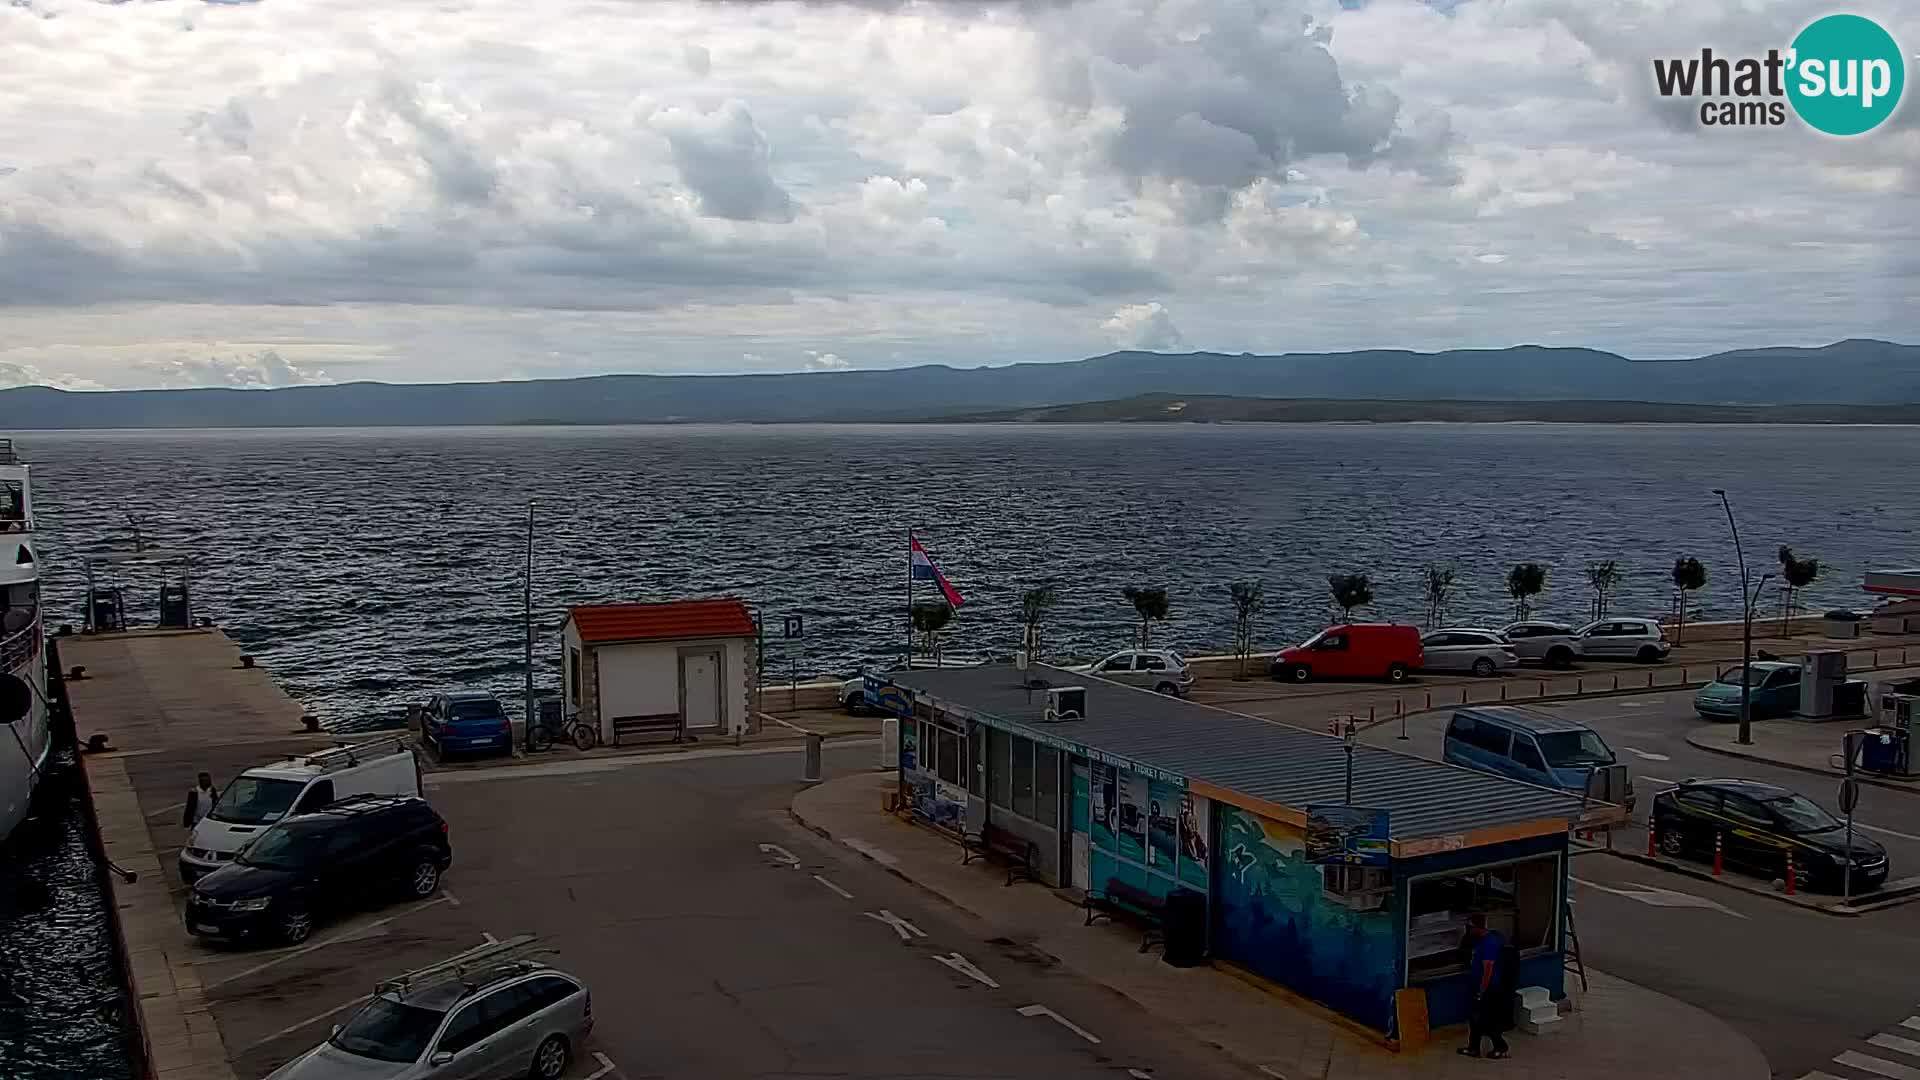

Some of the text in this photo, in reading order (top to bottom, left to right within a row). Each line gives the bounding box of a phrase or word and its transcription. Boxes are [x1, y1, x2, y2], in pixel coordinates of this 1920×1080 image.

[789, 620, 799, 635] P
[1102, 753, 1131, 770] STATION
[1133, 763, 1158, 779] TICKET
[1159, 771, 1185, 787] OFFICE
